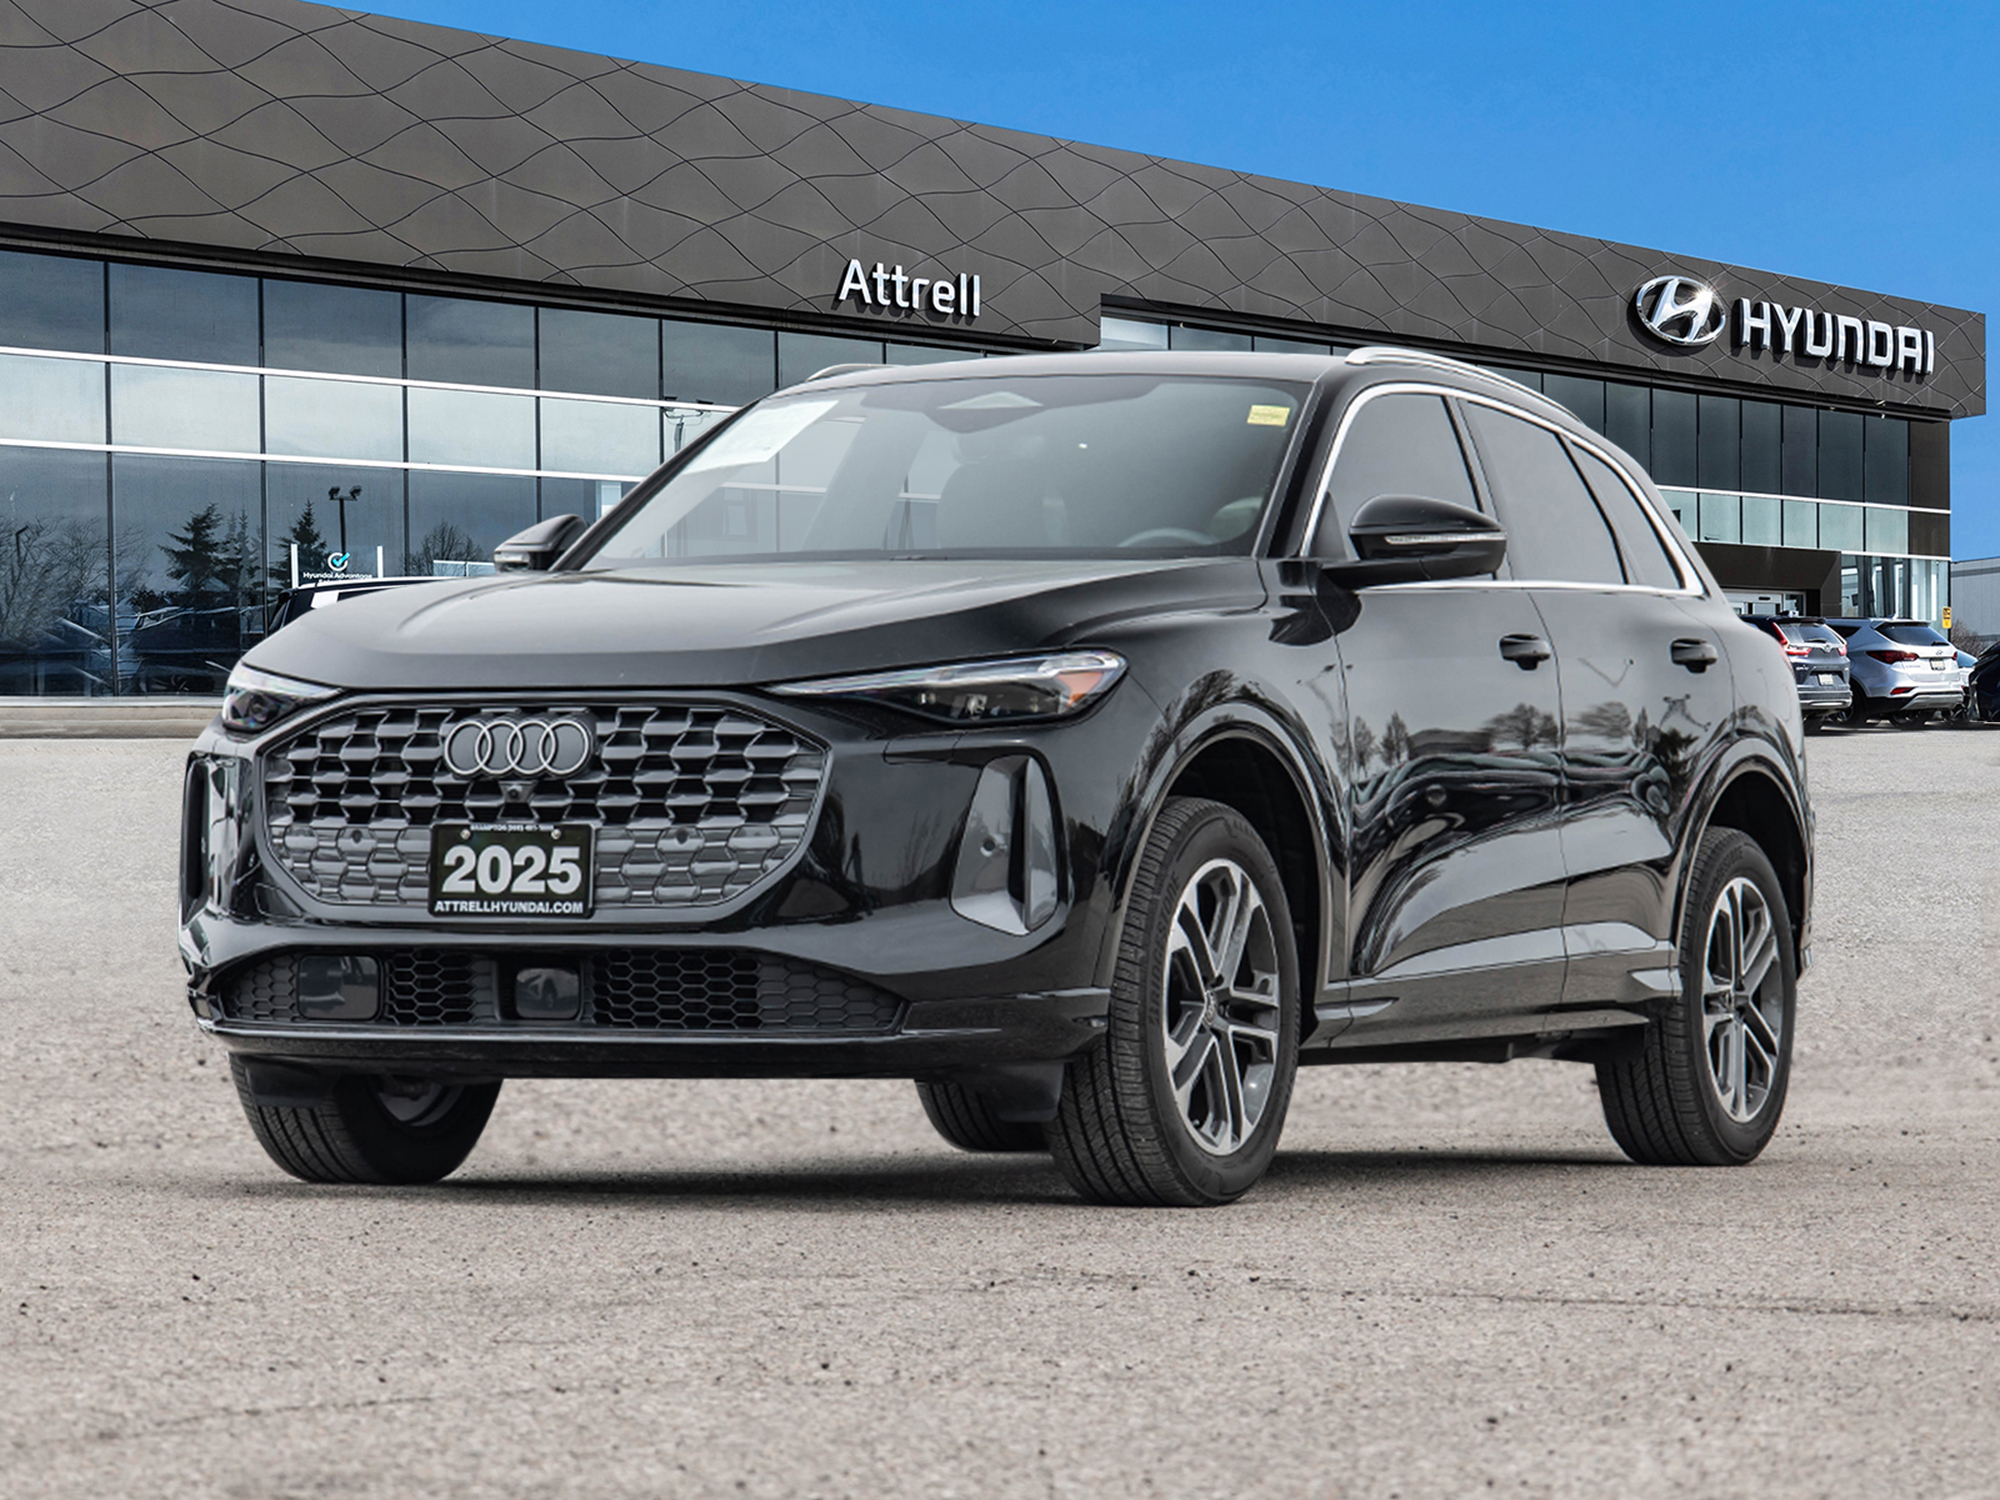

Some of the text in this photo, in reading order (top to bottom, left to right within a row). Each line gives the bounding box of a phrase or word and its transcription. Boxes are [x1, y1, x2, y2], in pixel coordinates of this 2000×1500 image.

[839, 258, 980, 317] Attrell
[1739, 297, 1935, 375] HYUNDAI
[303, 571, 333, 580] Hyundai
[441, 844, 582, 895] 2025
[434, 900, 584, 914] ATTRELLHYUNDAI.COM
